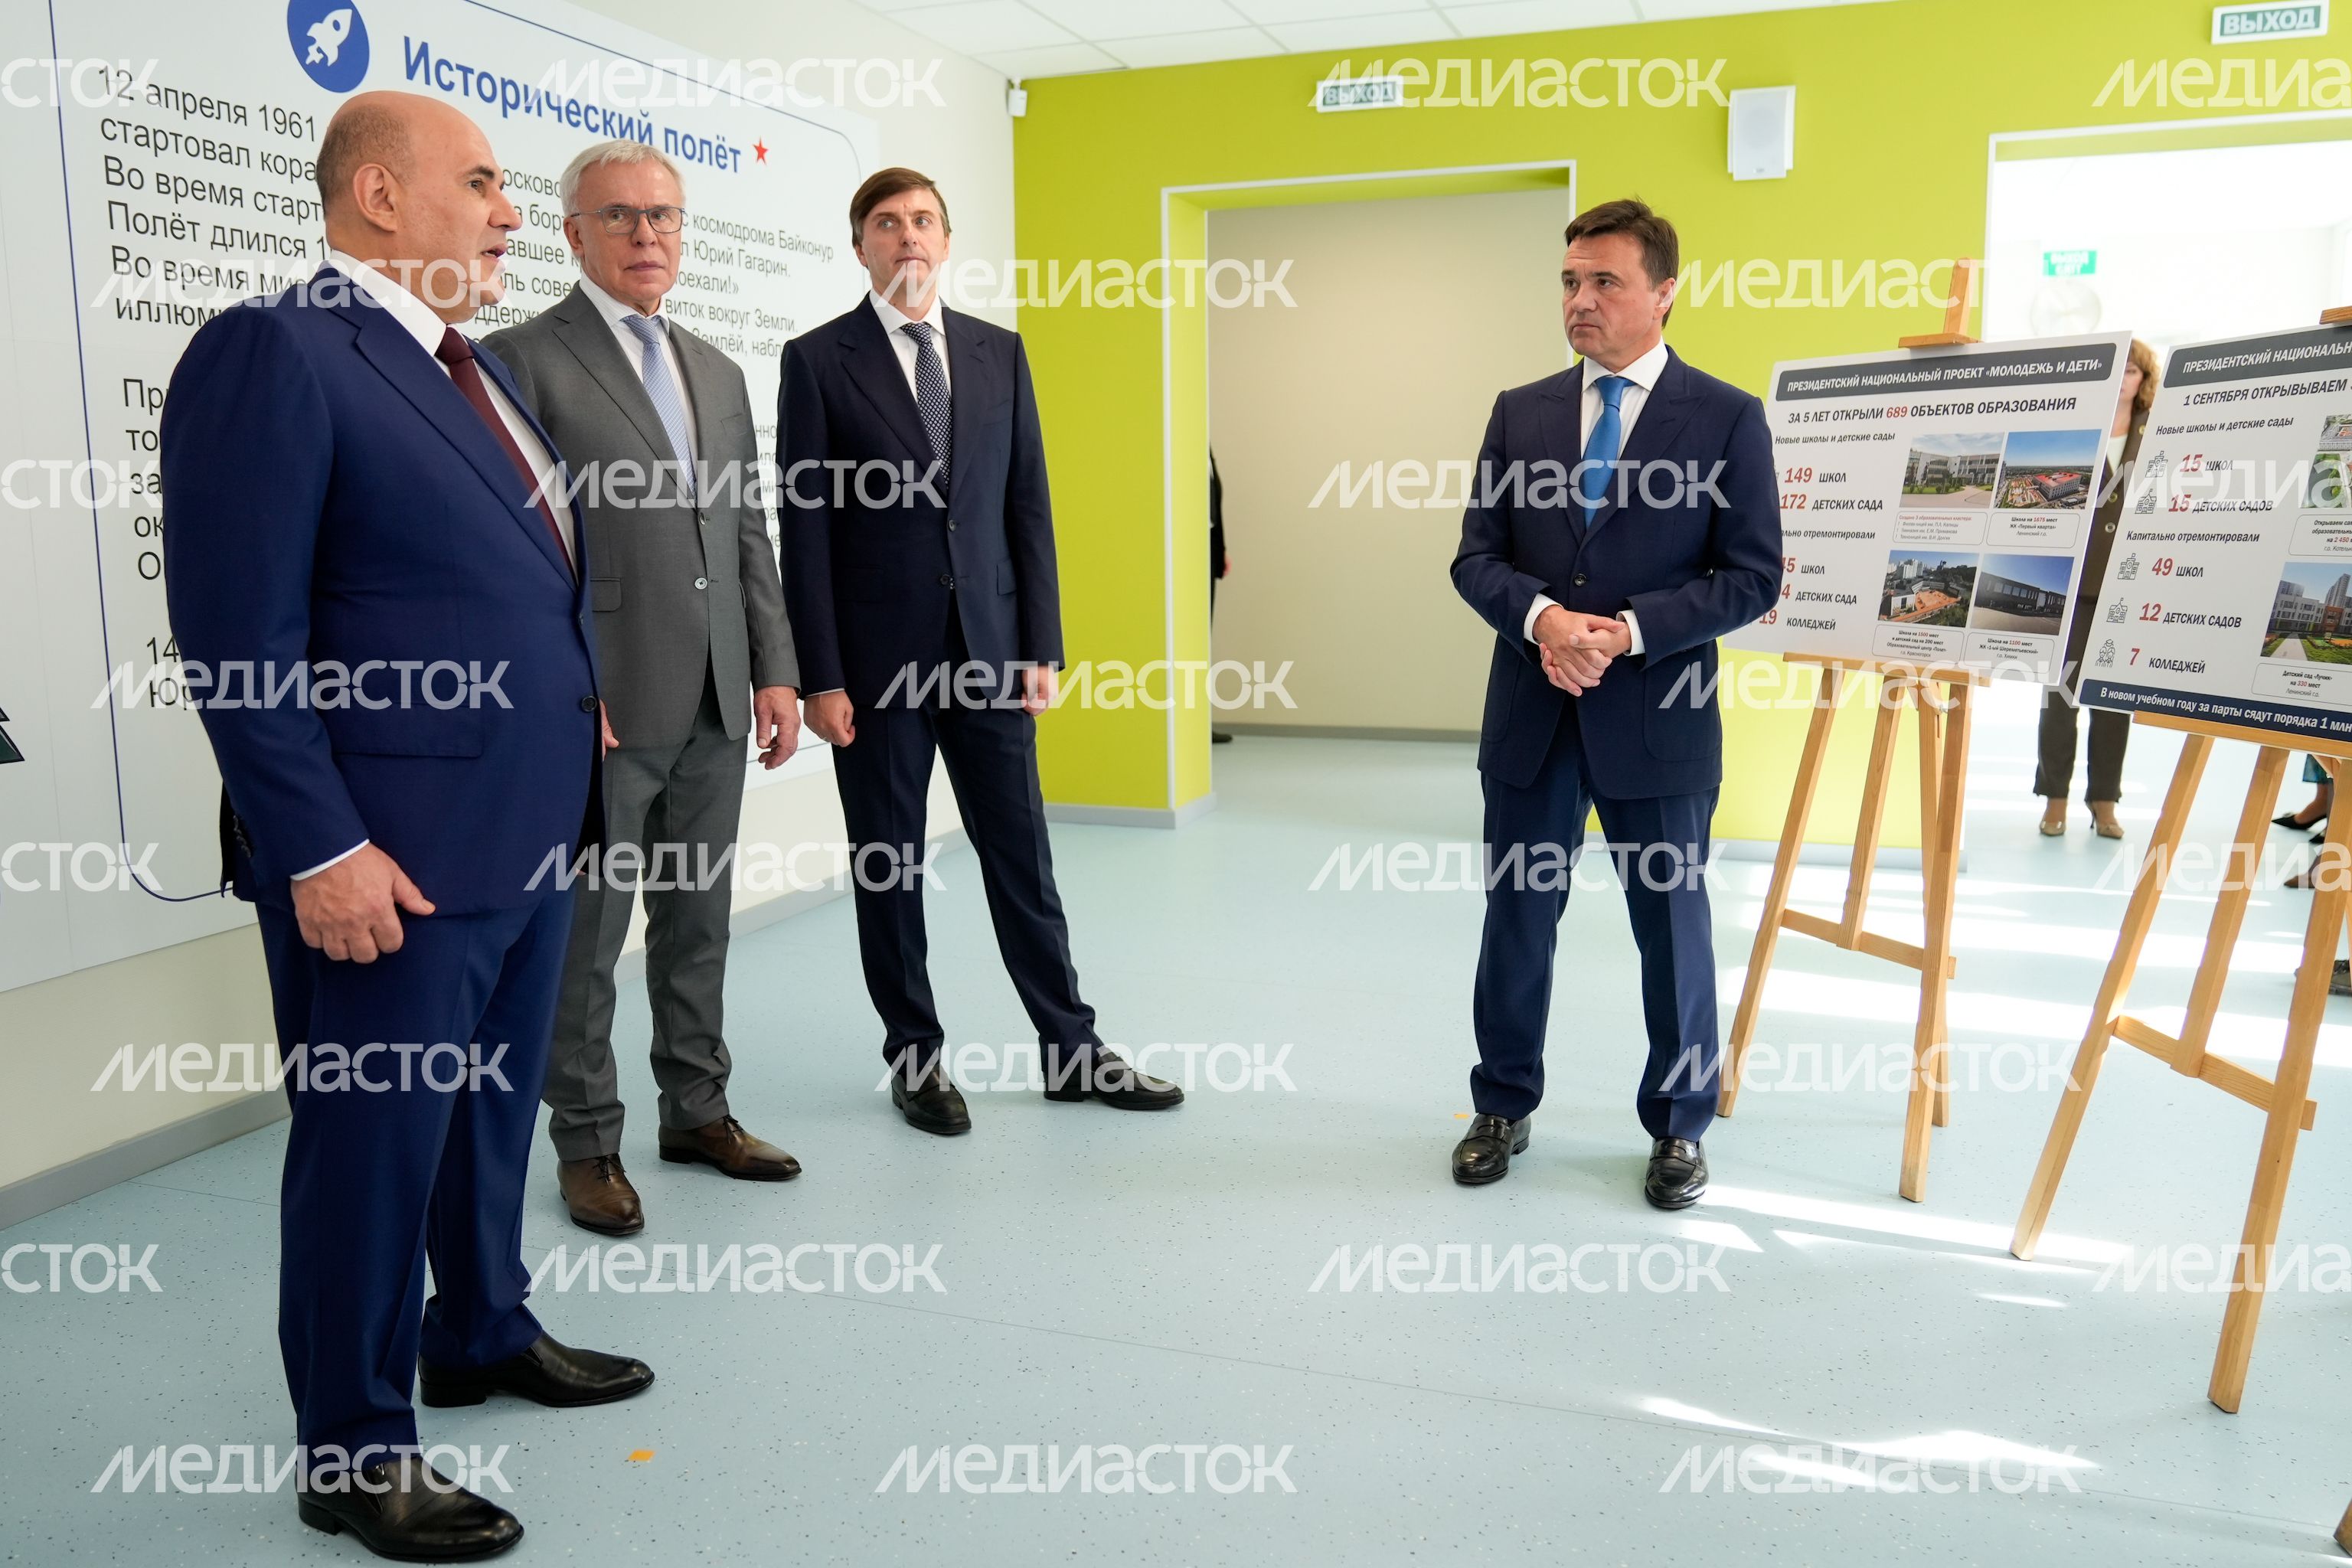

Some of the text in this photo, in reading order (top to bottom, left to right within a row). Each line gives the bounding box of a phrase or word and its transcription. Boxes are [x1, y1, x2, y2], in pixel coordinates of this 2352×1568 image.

[2223, 8, 2316, 35] ВЫХОД
[99, 65, 315, 142] 12 апреля 1961
[403, 35, 741, 174] Исторический полёт
[1325, 80, 1395, 105] ВЫХОД
[100, 118, 251, 168] стартовал
[104, 155, 145, 190] Во
[155, 172, 243, 208] время
[108, 200, 307, 259] Полёт длился
[693, 214, 835, 263] космодрома Байконур
[112, 245, 250, 291] Во время
[694, 240, 791, 277] Юрий Гагарин.
[676, 270, 740, 296] оехали!»
[665, 299, 799, 333] виток вокруг Земли.
[2183, 341, 2352, 374] ПРЕЗИДЕНТСКИЙ НАЦИОНАЛЬН
[1787, 358, 2102, 392] ПРЕЗИДЕНТСКИЙ НАЦИОНАЛЬНЫЙ ПРОЕКТ «МОЛОДЕЖЬ И ДЕТИ»
[1788, 397, 2077, 423] ЗА 5 ЛЕТ ОТКРЫЛИ 689 ОБЪЕКТОВ ОБРАЗОВАНИЯ
[2184, 394, 2190, 406] 1
[2193, 388, 2249, 405] СЕНТЯБРЯ
[1775, 436, 1800, 445] Новые
[1802, 434, 1828, 444] школы
[1838, 433, 1870, 443] детские
[1873, 430, 1895, 442] сады
[2156, 426, 2184, 436] Новые
[2186, 423, 2217, 433] школы
[2226, 420, 2265, 432] детские
[2267, 416, 2294, 427] сады
[1784, 467, 1847, 483] 149 ШКОЛ
[2180, 454, 2233, 472] 15 ШКОЛ
[1780, 493, 1883, 512] 172 ДЕТСКИХ САДА
[2168, 494, 2274, 514] 15 ДЕТСКИХ САДОВ
[1803, 530, 1876, 541] отремонтировали
[2127, 530, 2260, 544] Капитально отремонтировали
[1801, 564, 1825, 575] ШКОЛ
[2151, 557, 2203, 577] 49 ШКОЛ
[1795, 591, 1833, 603] ДЕТСКИХ
[1834, 593, 1857, 606] САДА
[1786, 616, 1837, 631] КОЛЛЕДЖЕЙ
[2139, 603, 2242, 629] 12 ДЕТСКИХ САДОВ
[2129, 648, 2206, 674] 7 КОЛЛЕДЖЕЙ
[2100, 687, 2108, 697] В
[2108, 688, 2136, 702] новом
[2136, 694, 2174, 707] учебном
[2176, 700, 2197, 713] году
[2198, 702, 2210, 712] за
[2211, 704, 2243, 718] парты
[2244, 709, 2273, 723] сядут
[2273, 713, 2318, 727] порядка
[2319, 717, 2328, 729] 1
